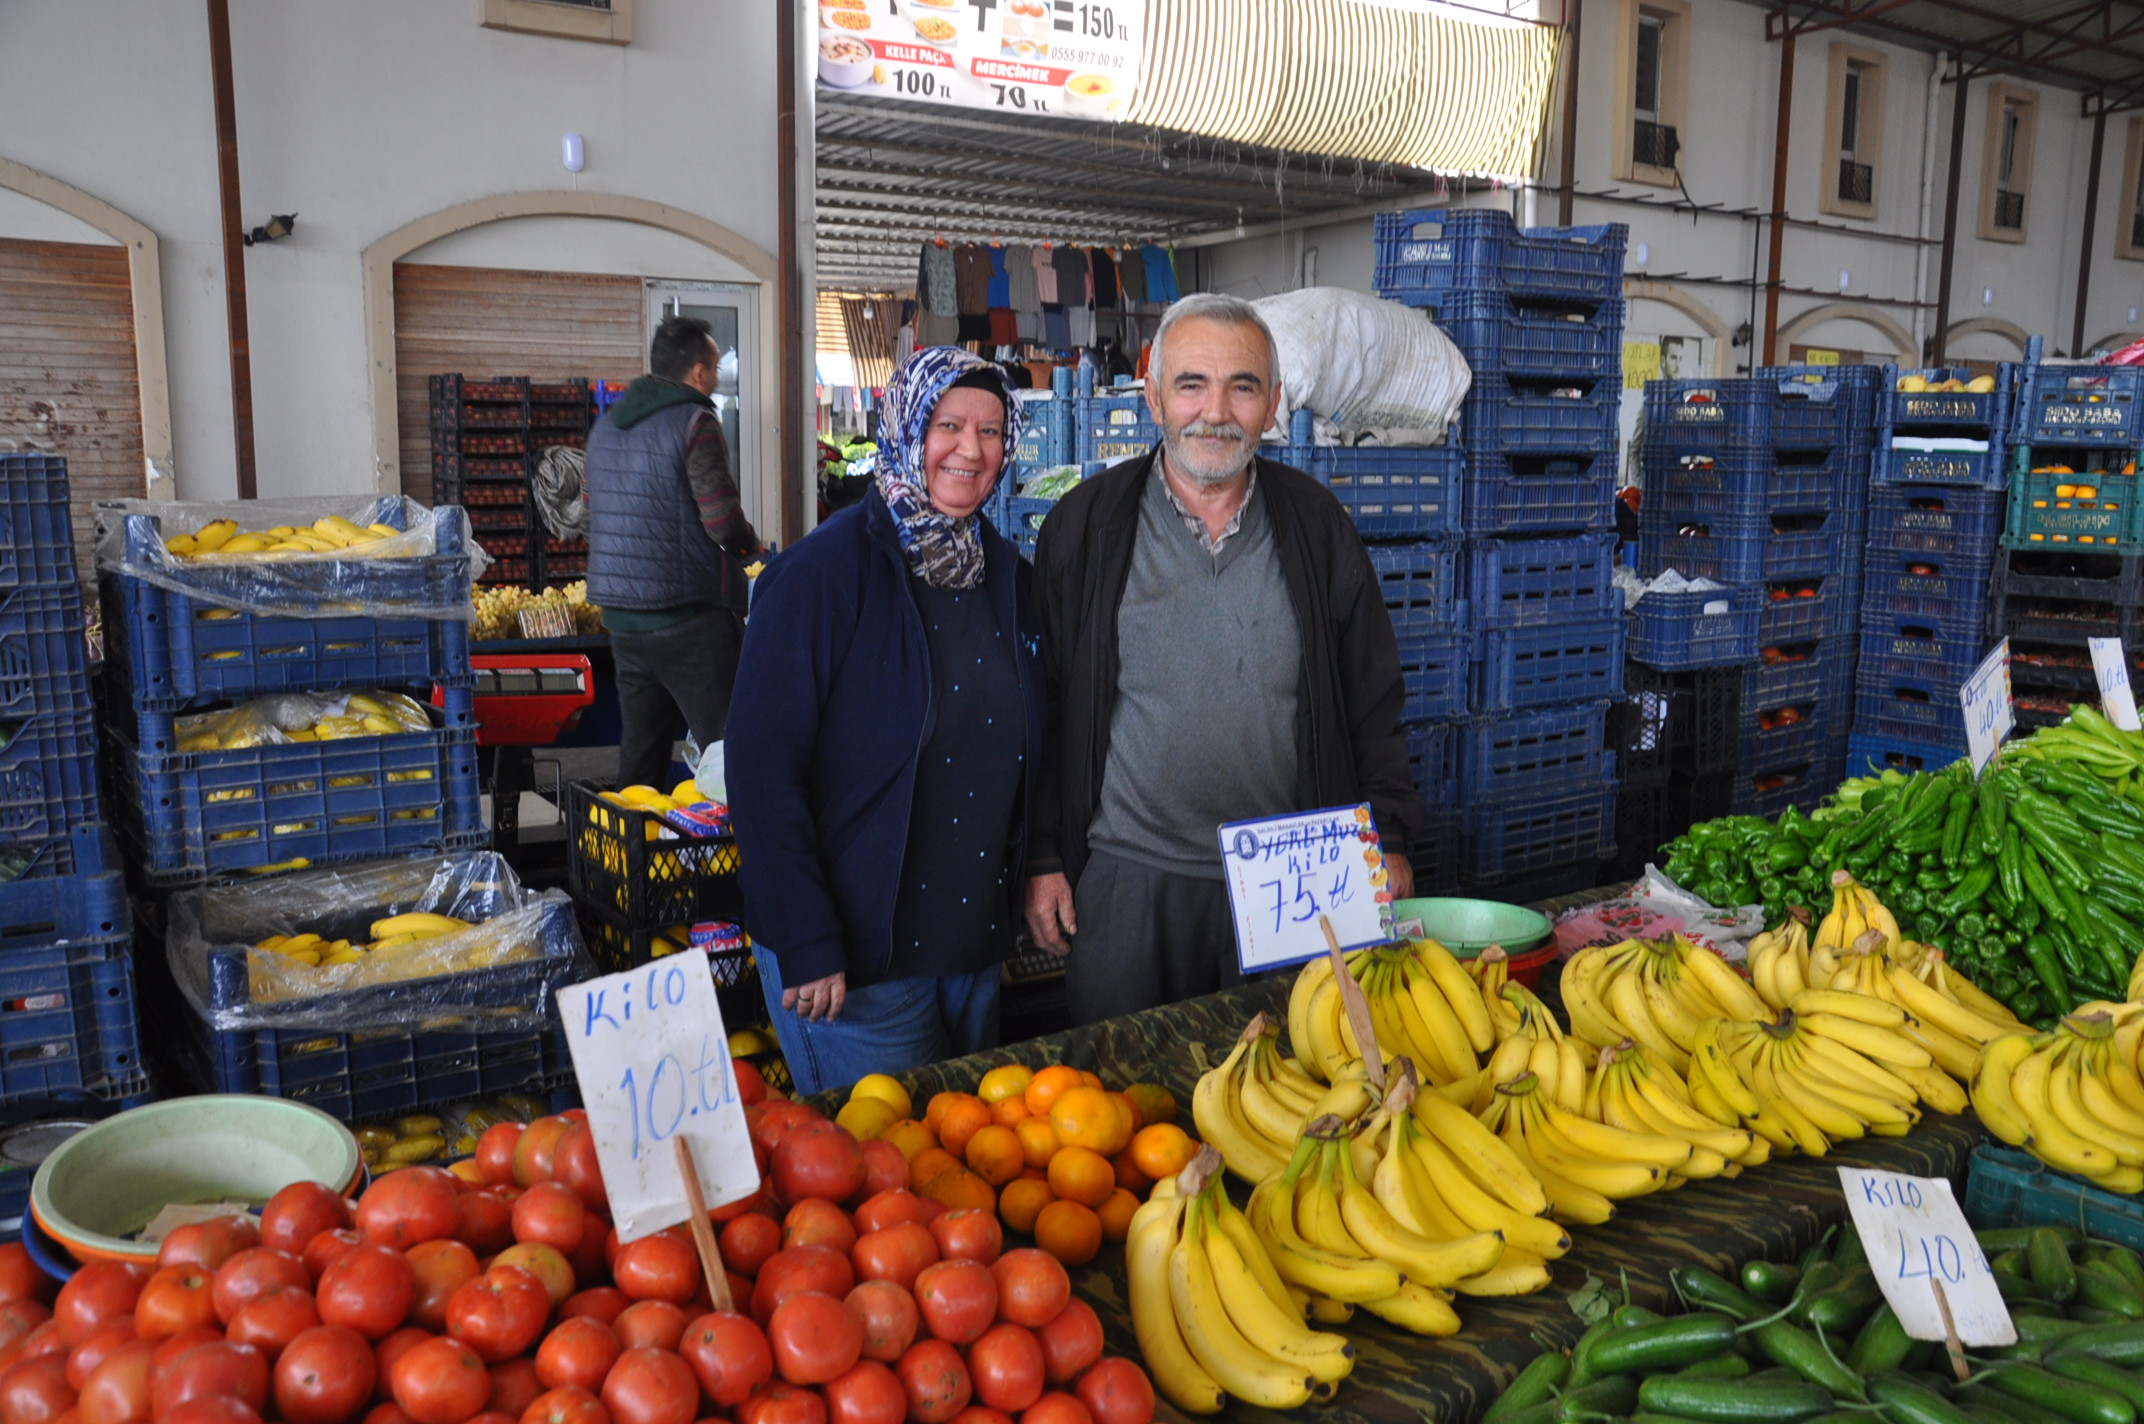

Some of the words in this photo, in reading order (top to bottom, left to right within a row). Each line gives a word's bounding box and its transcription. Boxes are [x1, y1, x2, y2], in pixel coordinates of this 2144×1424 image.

[885, 44, 917, 60] KELLE
[919, 48, 946, 66] PAÇA
[1051, 46, 1075, 62] 0555
[1078, 50, 1095, 64] 977
[1098, 53, 1109, 66] 00
[1113, 55, 1124, 68] 92
[975, 60, 1050, 83] MERCİMEK
[892, 69, 935, 96] 100
[940, 84, 951, 99] TL
[990, 83, 1026, 109] 70
[1032, 98, 1050, 112] TL
